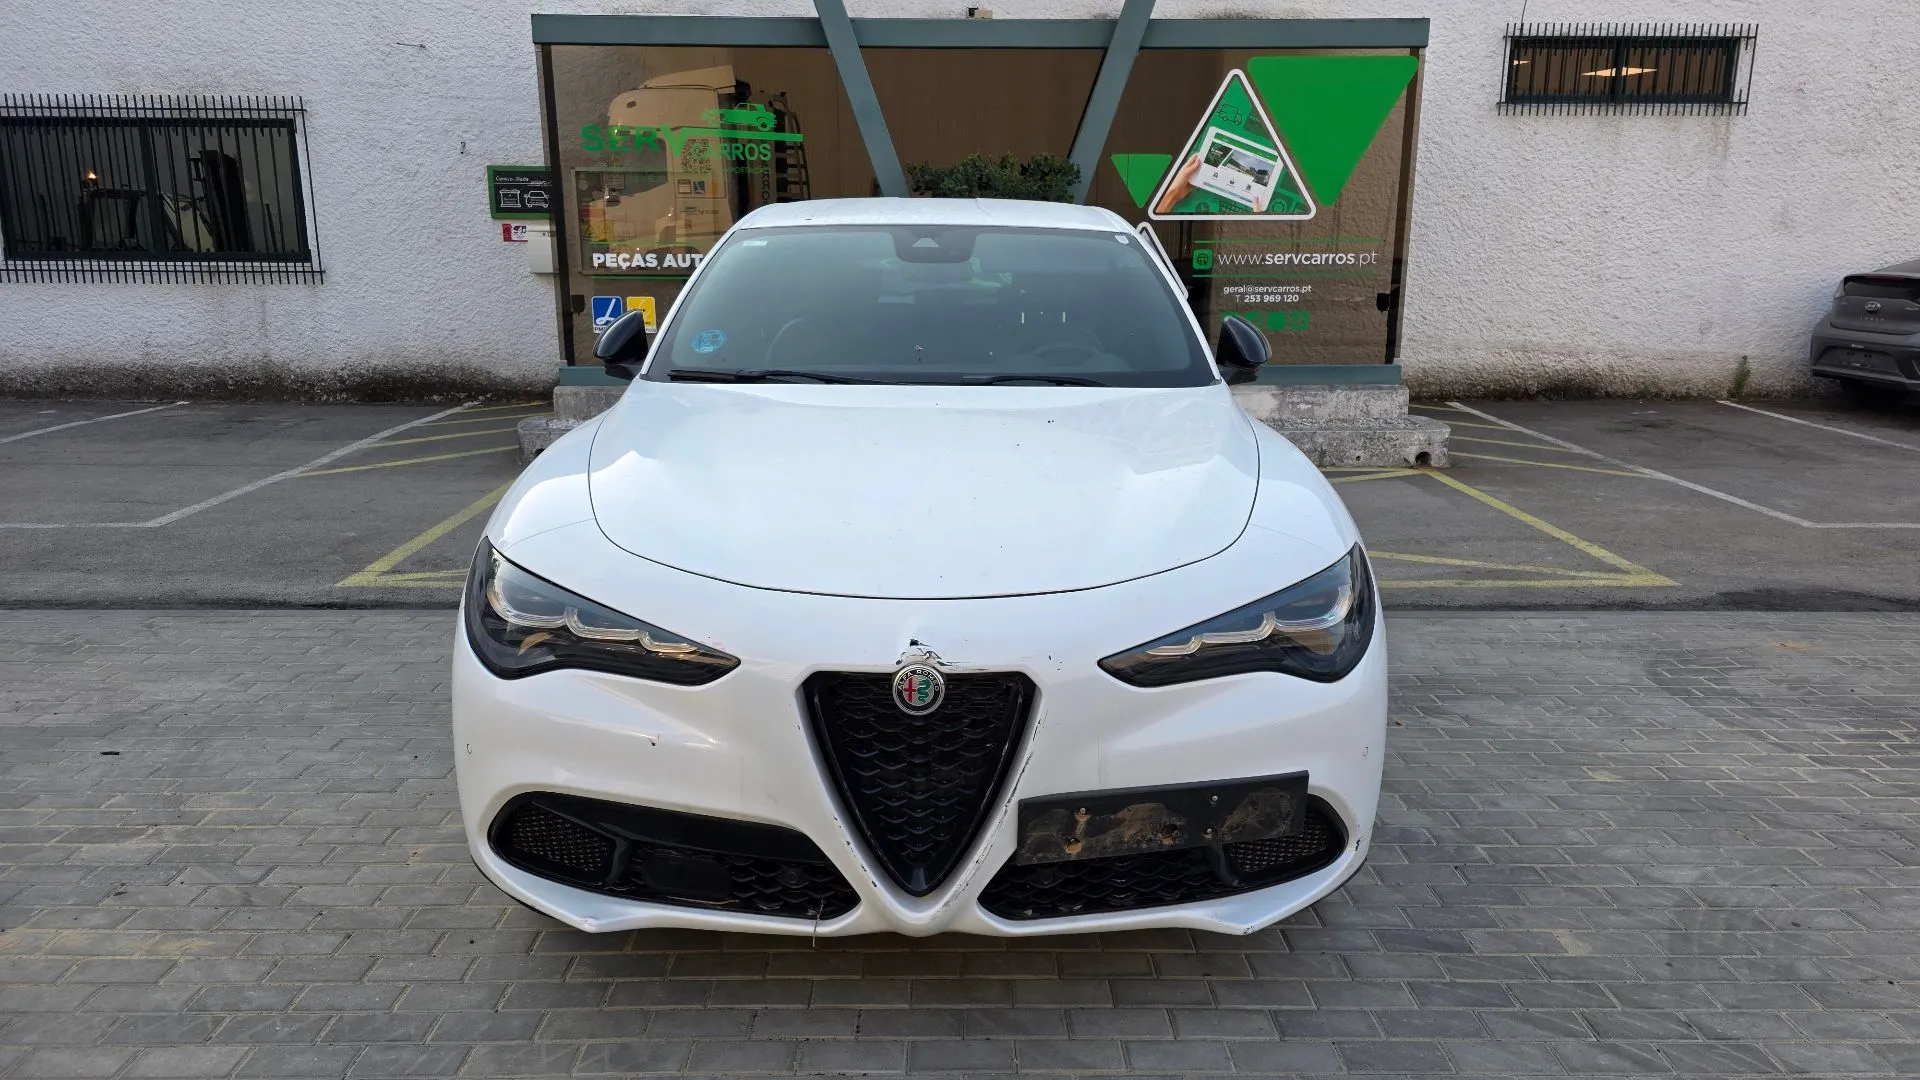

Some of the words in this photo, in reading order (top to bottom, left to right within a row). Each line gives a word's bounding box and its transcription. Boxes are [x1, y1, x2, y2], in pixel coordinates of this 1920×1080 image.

[581, 123, 690, 157] SERV
[592, 252, 658, 270] PEÇAS
[662, 253, 705, 268] AUT
[1218, 251, 1377, 267] www.servcarros.pt
[1223, 285, 1312, 294] geral@servcarros.pt
[1235, 295, 1242, 303] T.
[1244, 294, 1261, 303] 253
[1263, 294, 1281, 303] 969
[1283, 294, 1300, 303] 120
[898, 671, 913, 691] ALFA
[916, 669, 940, 692] ROMEO
